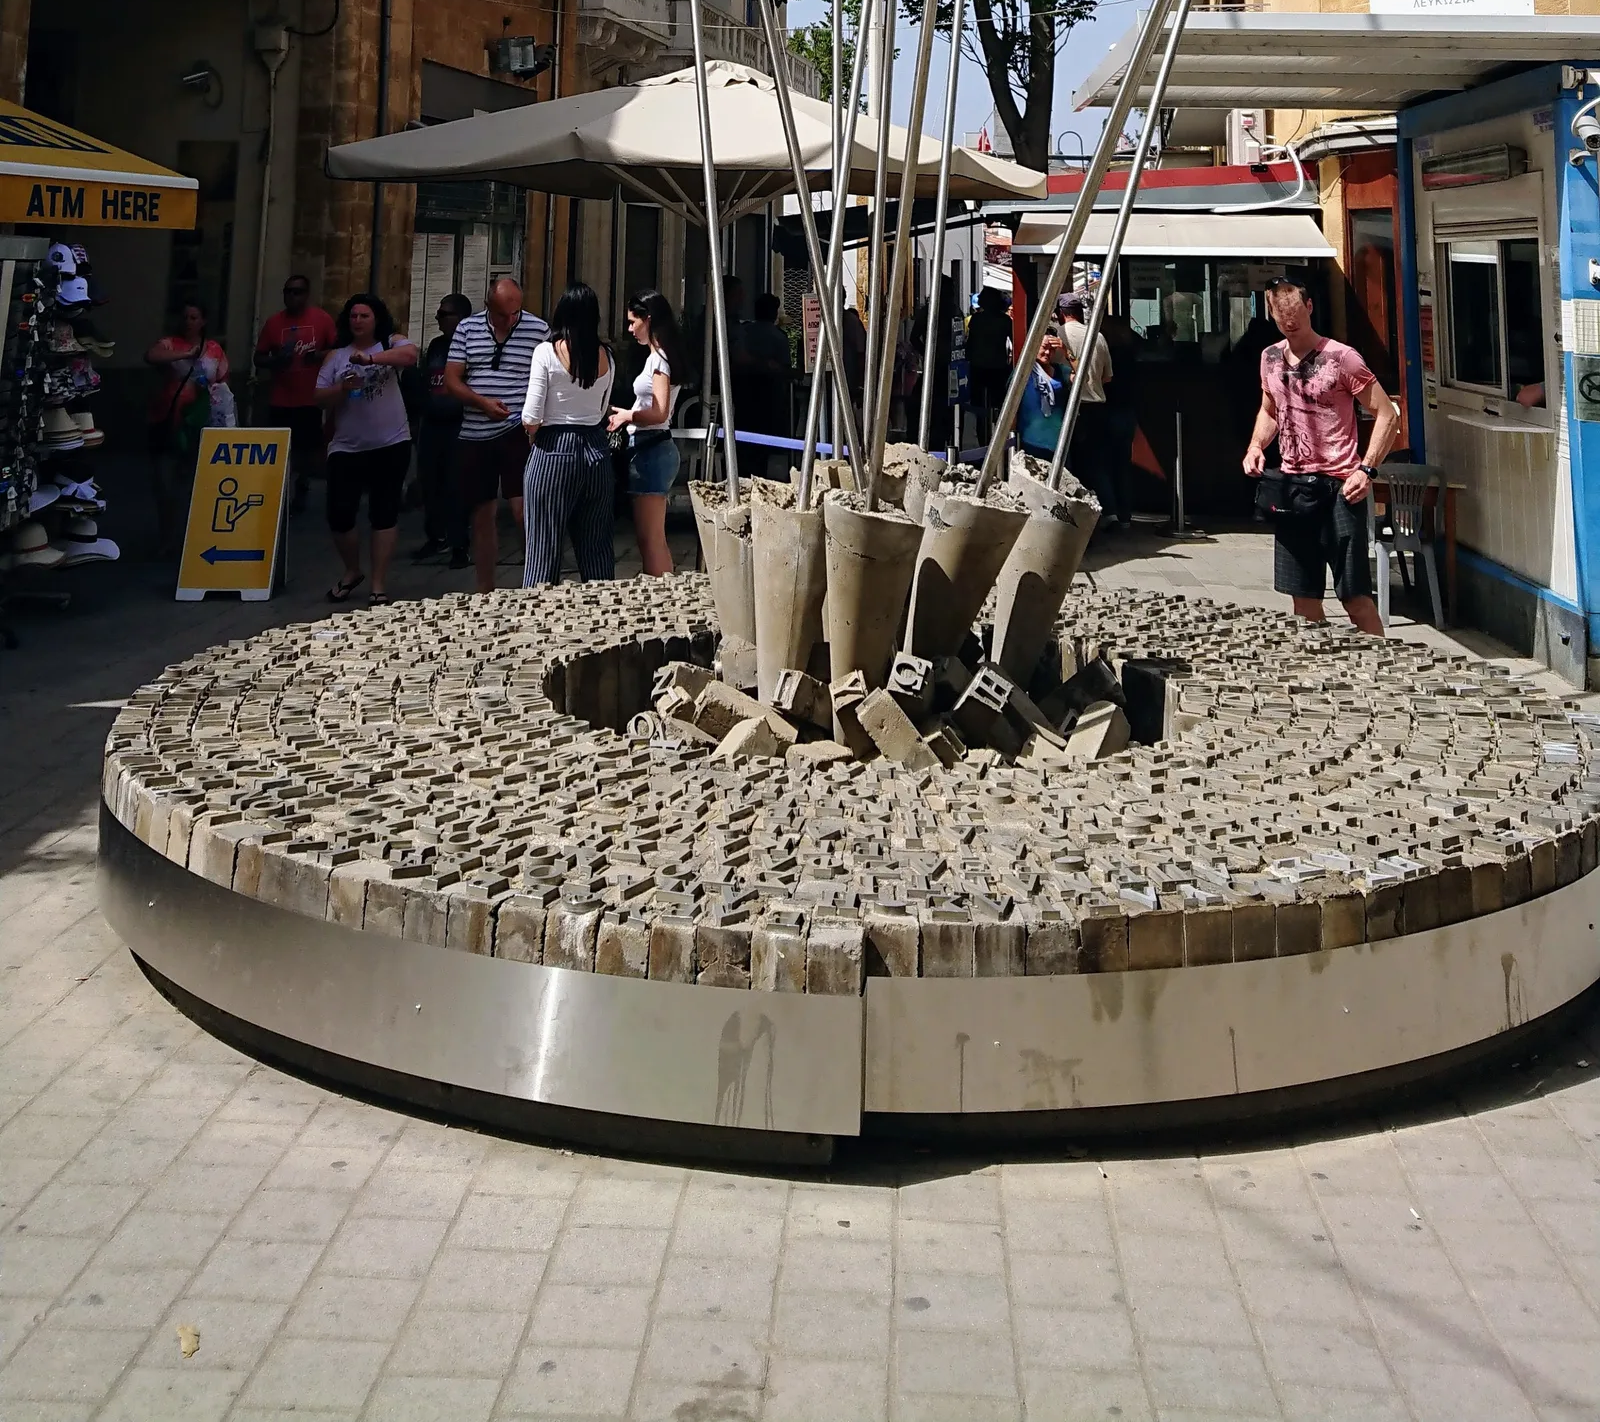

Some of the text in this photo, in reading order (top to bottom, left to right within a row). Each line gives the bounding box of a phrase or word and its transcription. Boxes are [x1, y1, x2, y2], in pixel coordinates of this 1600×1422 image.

[26, 184, 161, 222] ATM HERE
[209, 443, 278, 465] ATM
